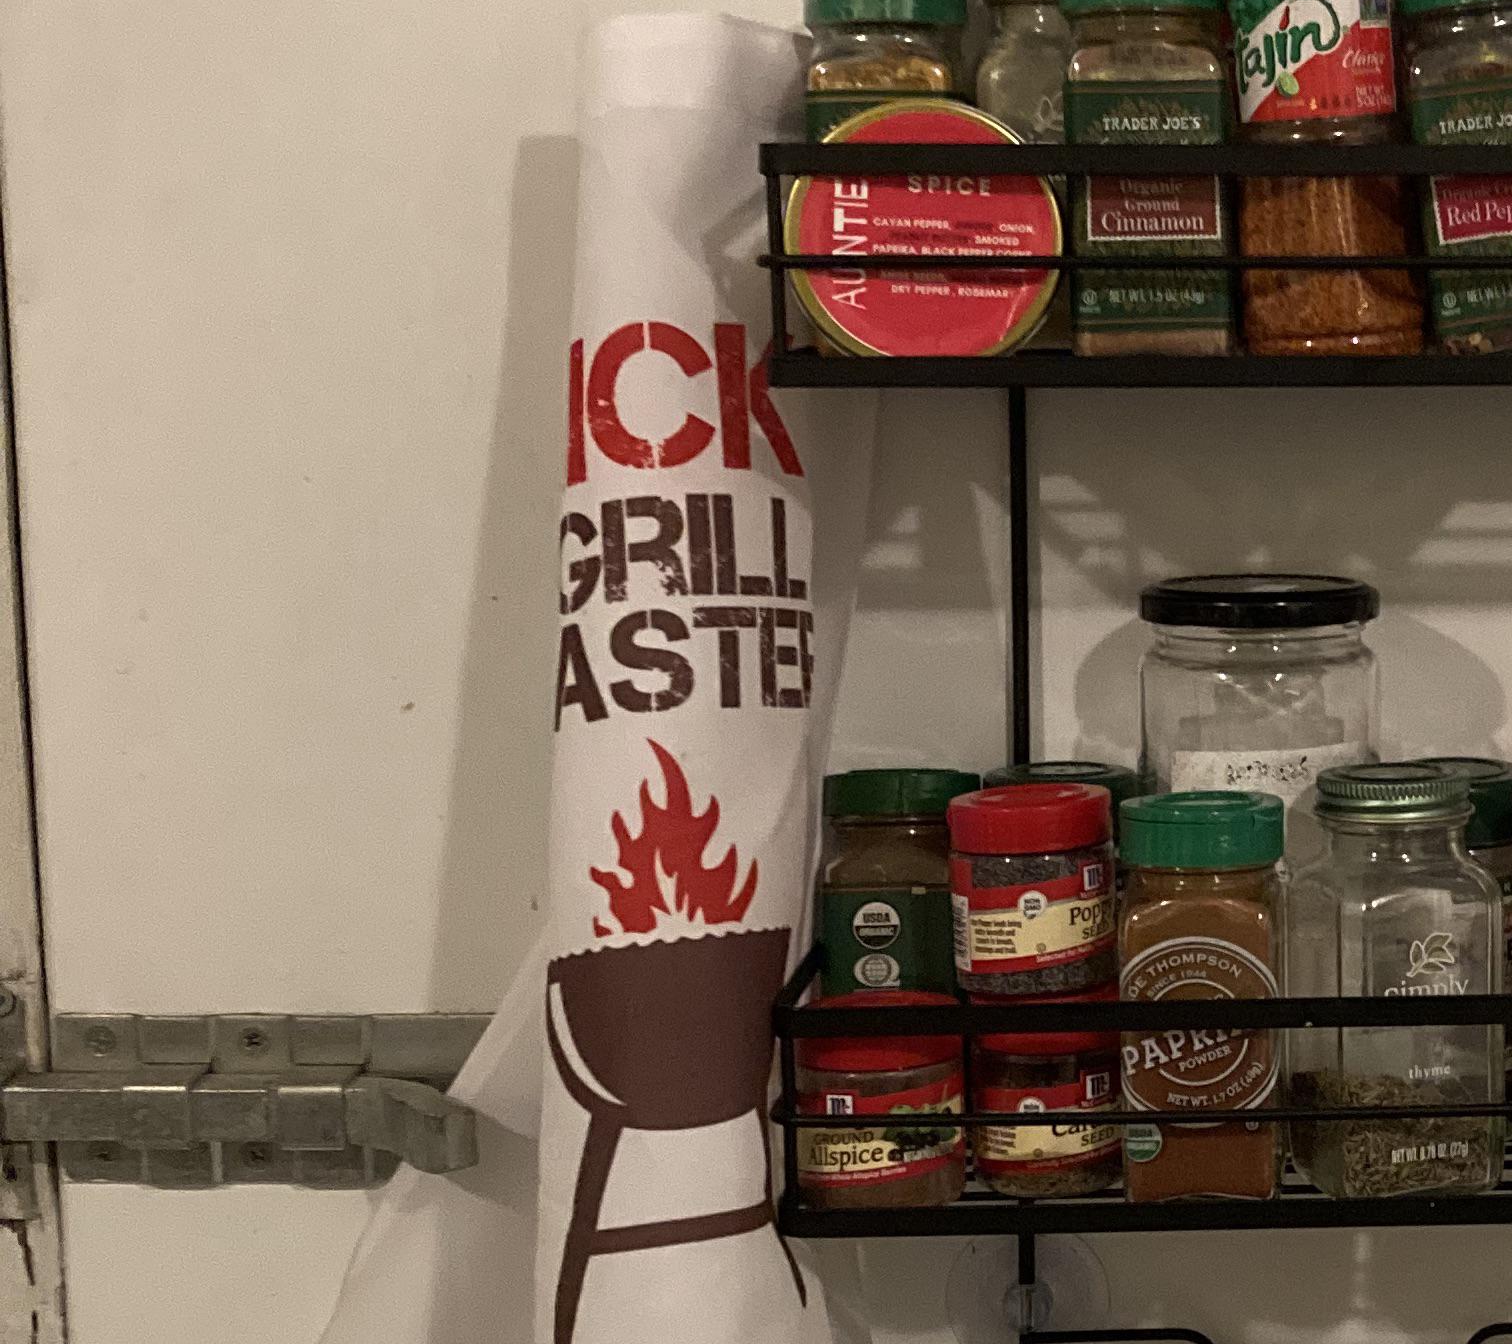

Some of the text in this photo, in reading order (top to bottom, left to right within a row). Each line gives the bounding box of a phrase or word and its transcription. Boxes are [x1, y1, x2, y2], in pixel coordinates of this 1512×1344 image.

[1102, 116, 1202, 131] TRADER JOE'S
[1439, 115, 1493, 134] TRADER
[907, 175, 991, 197] SPICE
[1124, 198, 1181, 212] Ground
[1446, 201, 1482, 227] Red
[1101, 211, 1205, 232] Cinnamon
[831, 177, 869, 310] AUNTIE
[559, 493, 807, 614] GRILL
[1145, 953, 1242, 979] THOMPSON
[1178, 1044, 1232, 1072] POWDER
[1408, 1064, 1452, 1080] thyme
[814, 1131, 875, 1146] GROUND
[1080, 1127, 1114, 1147] SEED
[810, 1146, 885, 1172] Allspice
